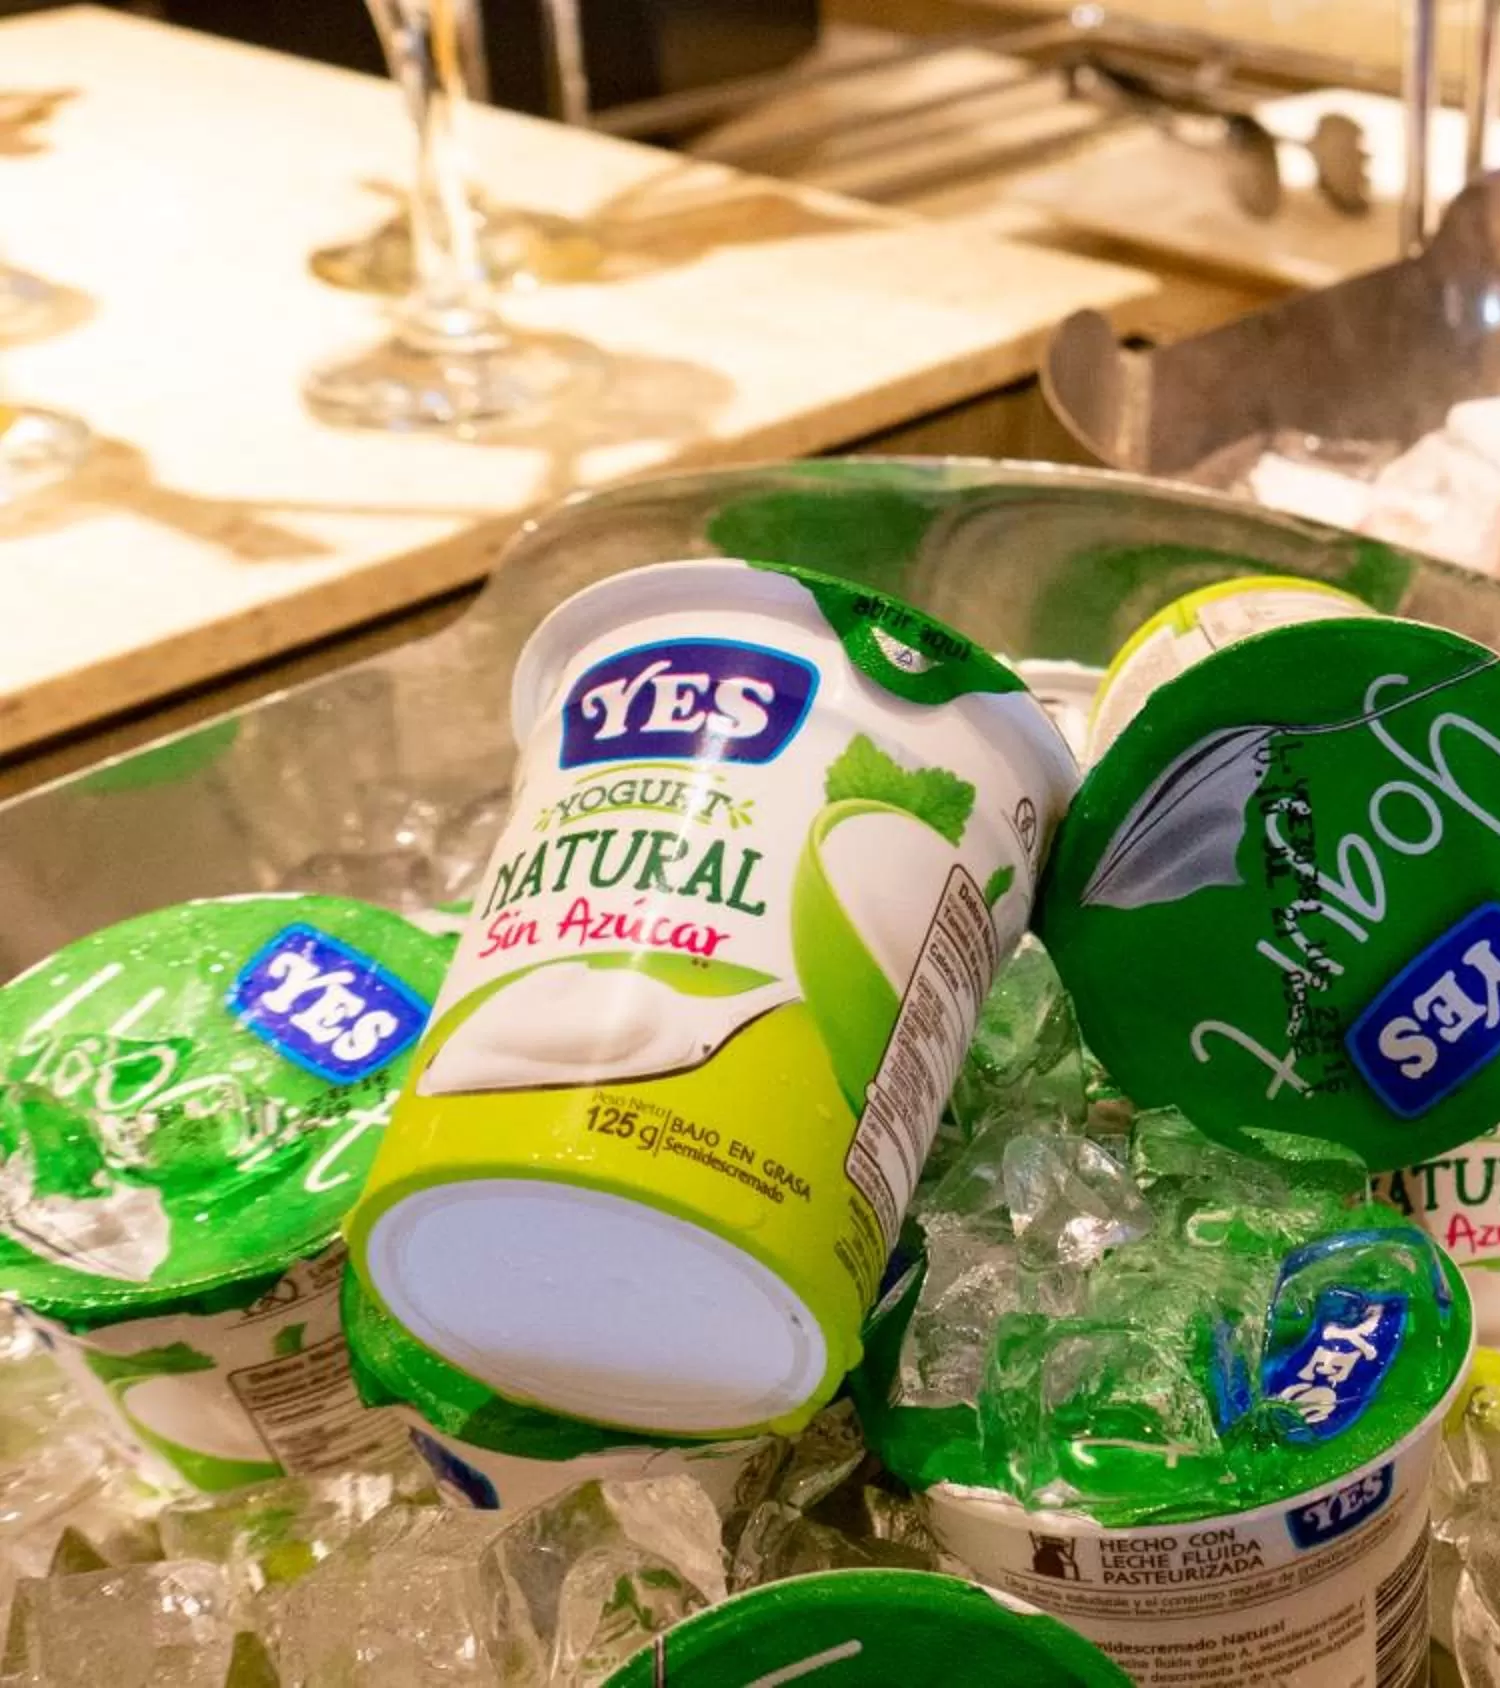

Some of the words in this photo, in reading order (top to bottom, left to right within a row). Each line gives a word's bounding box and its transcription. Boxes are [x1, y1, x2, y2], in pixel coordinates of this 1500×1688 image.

[581, 659, 775, 740] YES
[555, 779, 733, 819] YOGURT
[480, 828, 767, 921] NATURAL
[478, 909, 541, 958] Sin
[556, 896, 731, 957] Azúcar
[260, 951, 400, 1062] YES
[586, 1105, 638, 1139] 125
[637, 1124, 659, 1150] g
[662, 1136, 785, 1204] Semidescremado
[669, 1116, 721, 1148] BAJO
[728, 1140, 755, 1165] EN
[762, 1158, 813, 1203] GRASA
[1279, 1304, 1384, 1425] YES
[1303, 1470, 1384, 1532] YES
[1099, 1537, 1178, 1554] HECHO
[1189, 1528, 1236, 1546] CON
[1101, 1553, 1170, 1570] LECHE
[1182, 1539, 1262, 1568] FLUIDA
[1103, 1556, 1265, 1585] PASTEURIZADA
[1221, 1619, 1286, 1647] Natural
